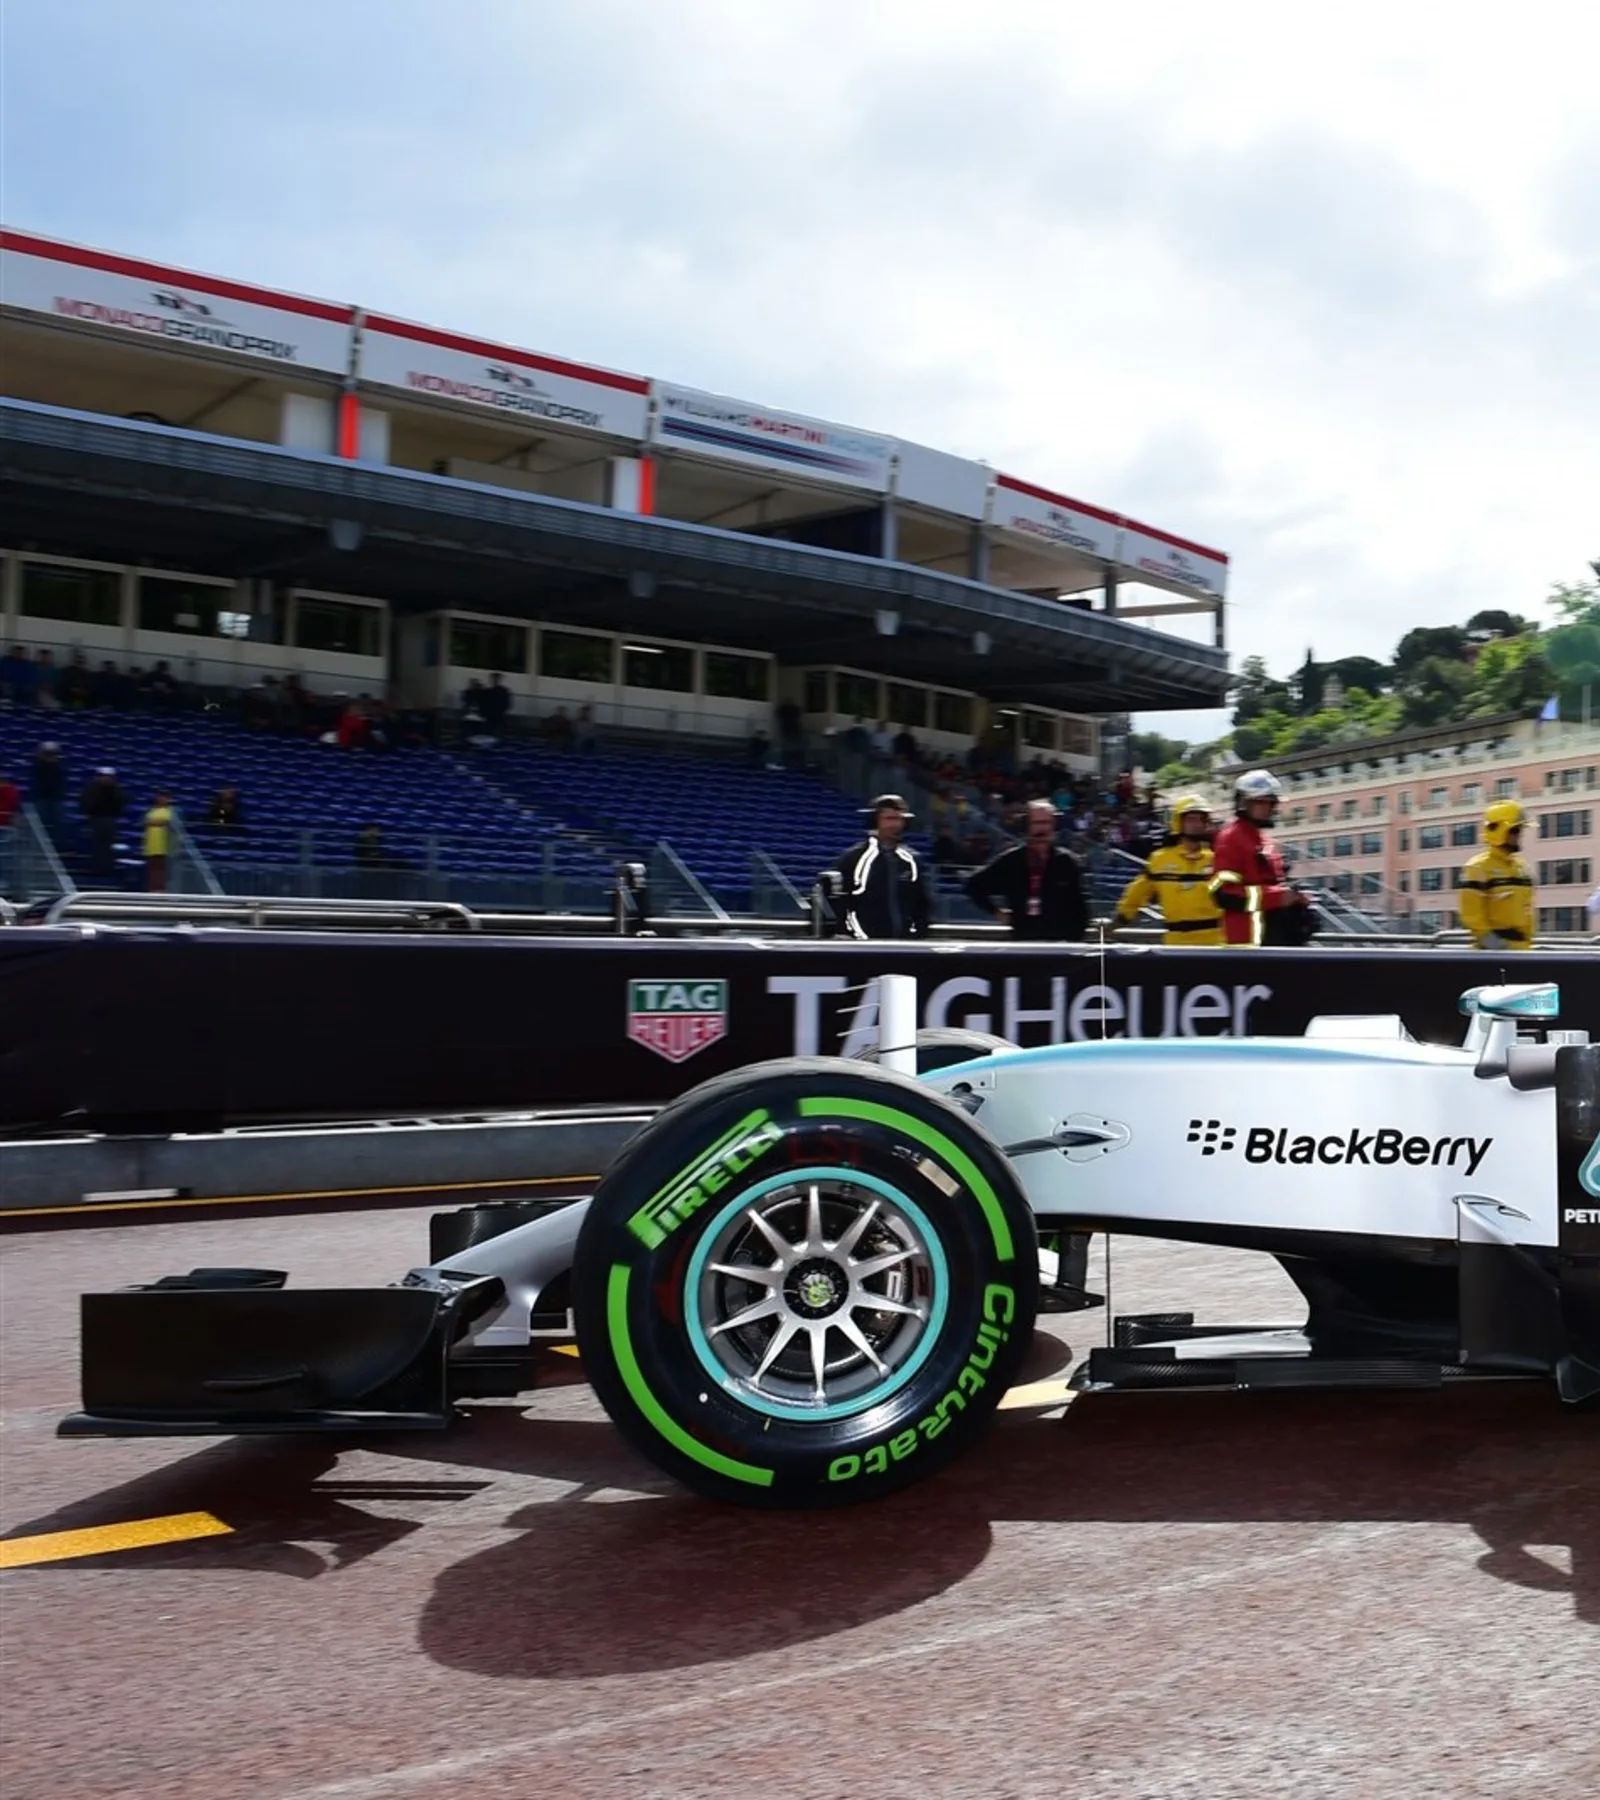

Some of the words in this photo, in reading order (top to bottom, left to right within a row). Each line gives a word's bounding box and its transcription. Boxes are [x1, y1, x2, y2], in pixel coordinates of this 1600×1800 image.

[636, 984, 719, 1010] TAG
[632, 1017, 724, 1055] HEUER
[1245, 1127, 1493, 1176] BlackBerry
[626, 1108, 787, 1251] PIRELLI
[826, 1282, 1016, 1483] Cinturato
